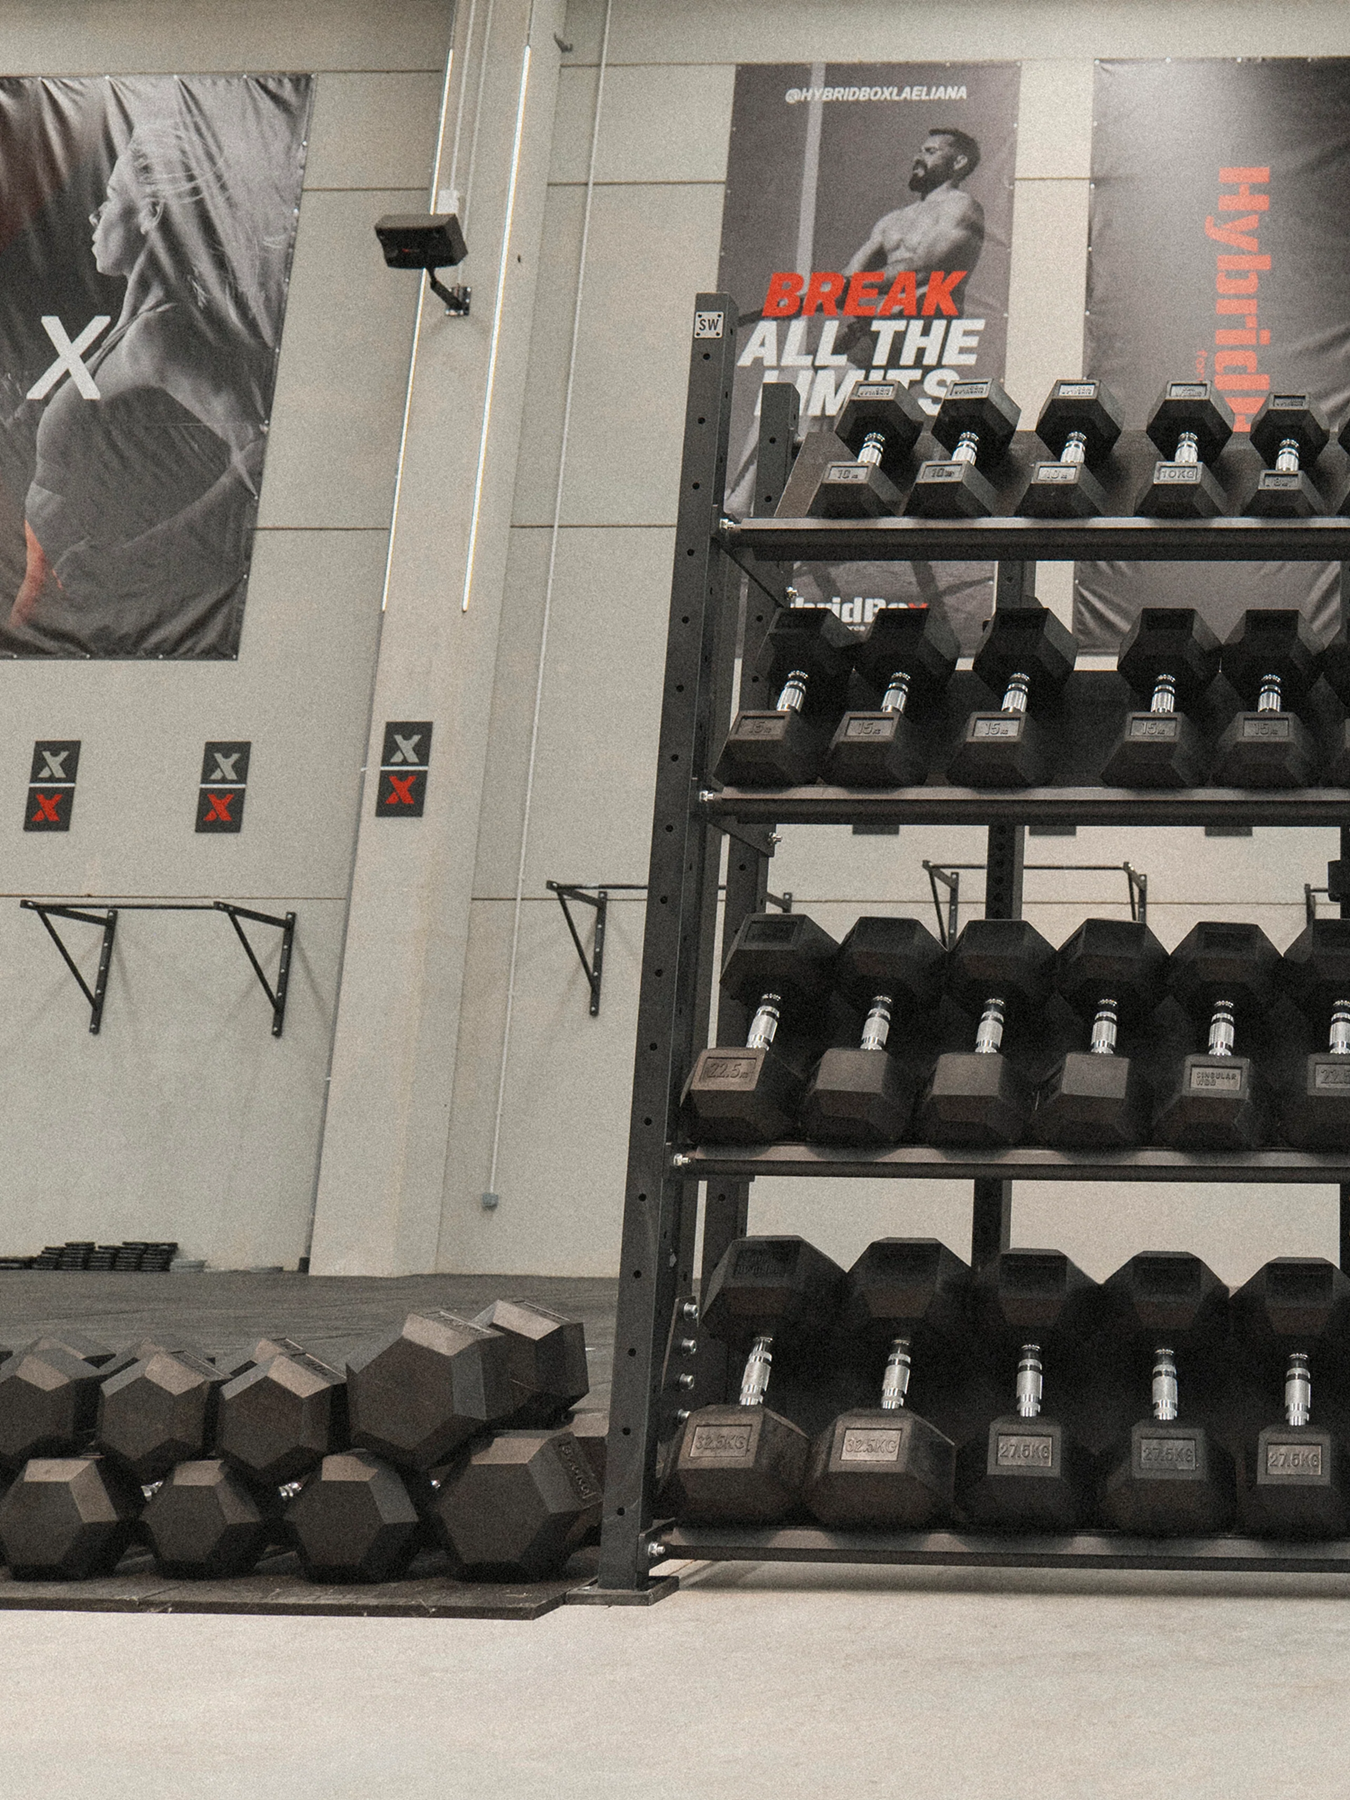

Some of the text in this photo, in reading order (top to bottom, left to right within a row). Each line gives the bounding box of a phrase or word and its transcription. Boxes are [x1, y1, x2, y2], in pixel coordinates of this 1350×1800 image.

[785, 86, 967, 104] @HYBRIDBOXLAELIANA
[762, 271, 967, 317] BREAK
[699, 318, 719, 331] SW
[737, 319, 986, 367] ALL THE
[26, 315, 111, 400] X
[999, 1443, 1051, 1460] 27.5KG
[1142, 1446, 1194, 1464] 27.5KG
[1269, 1451, 1320, 1469] 27.5KG
